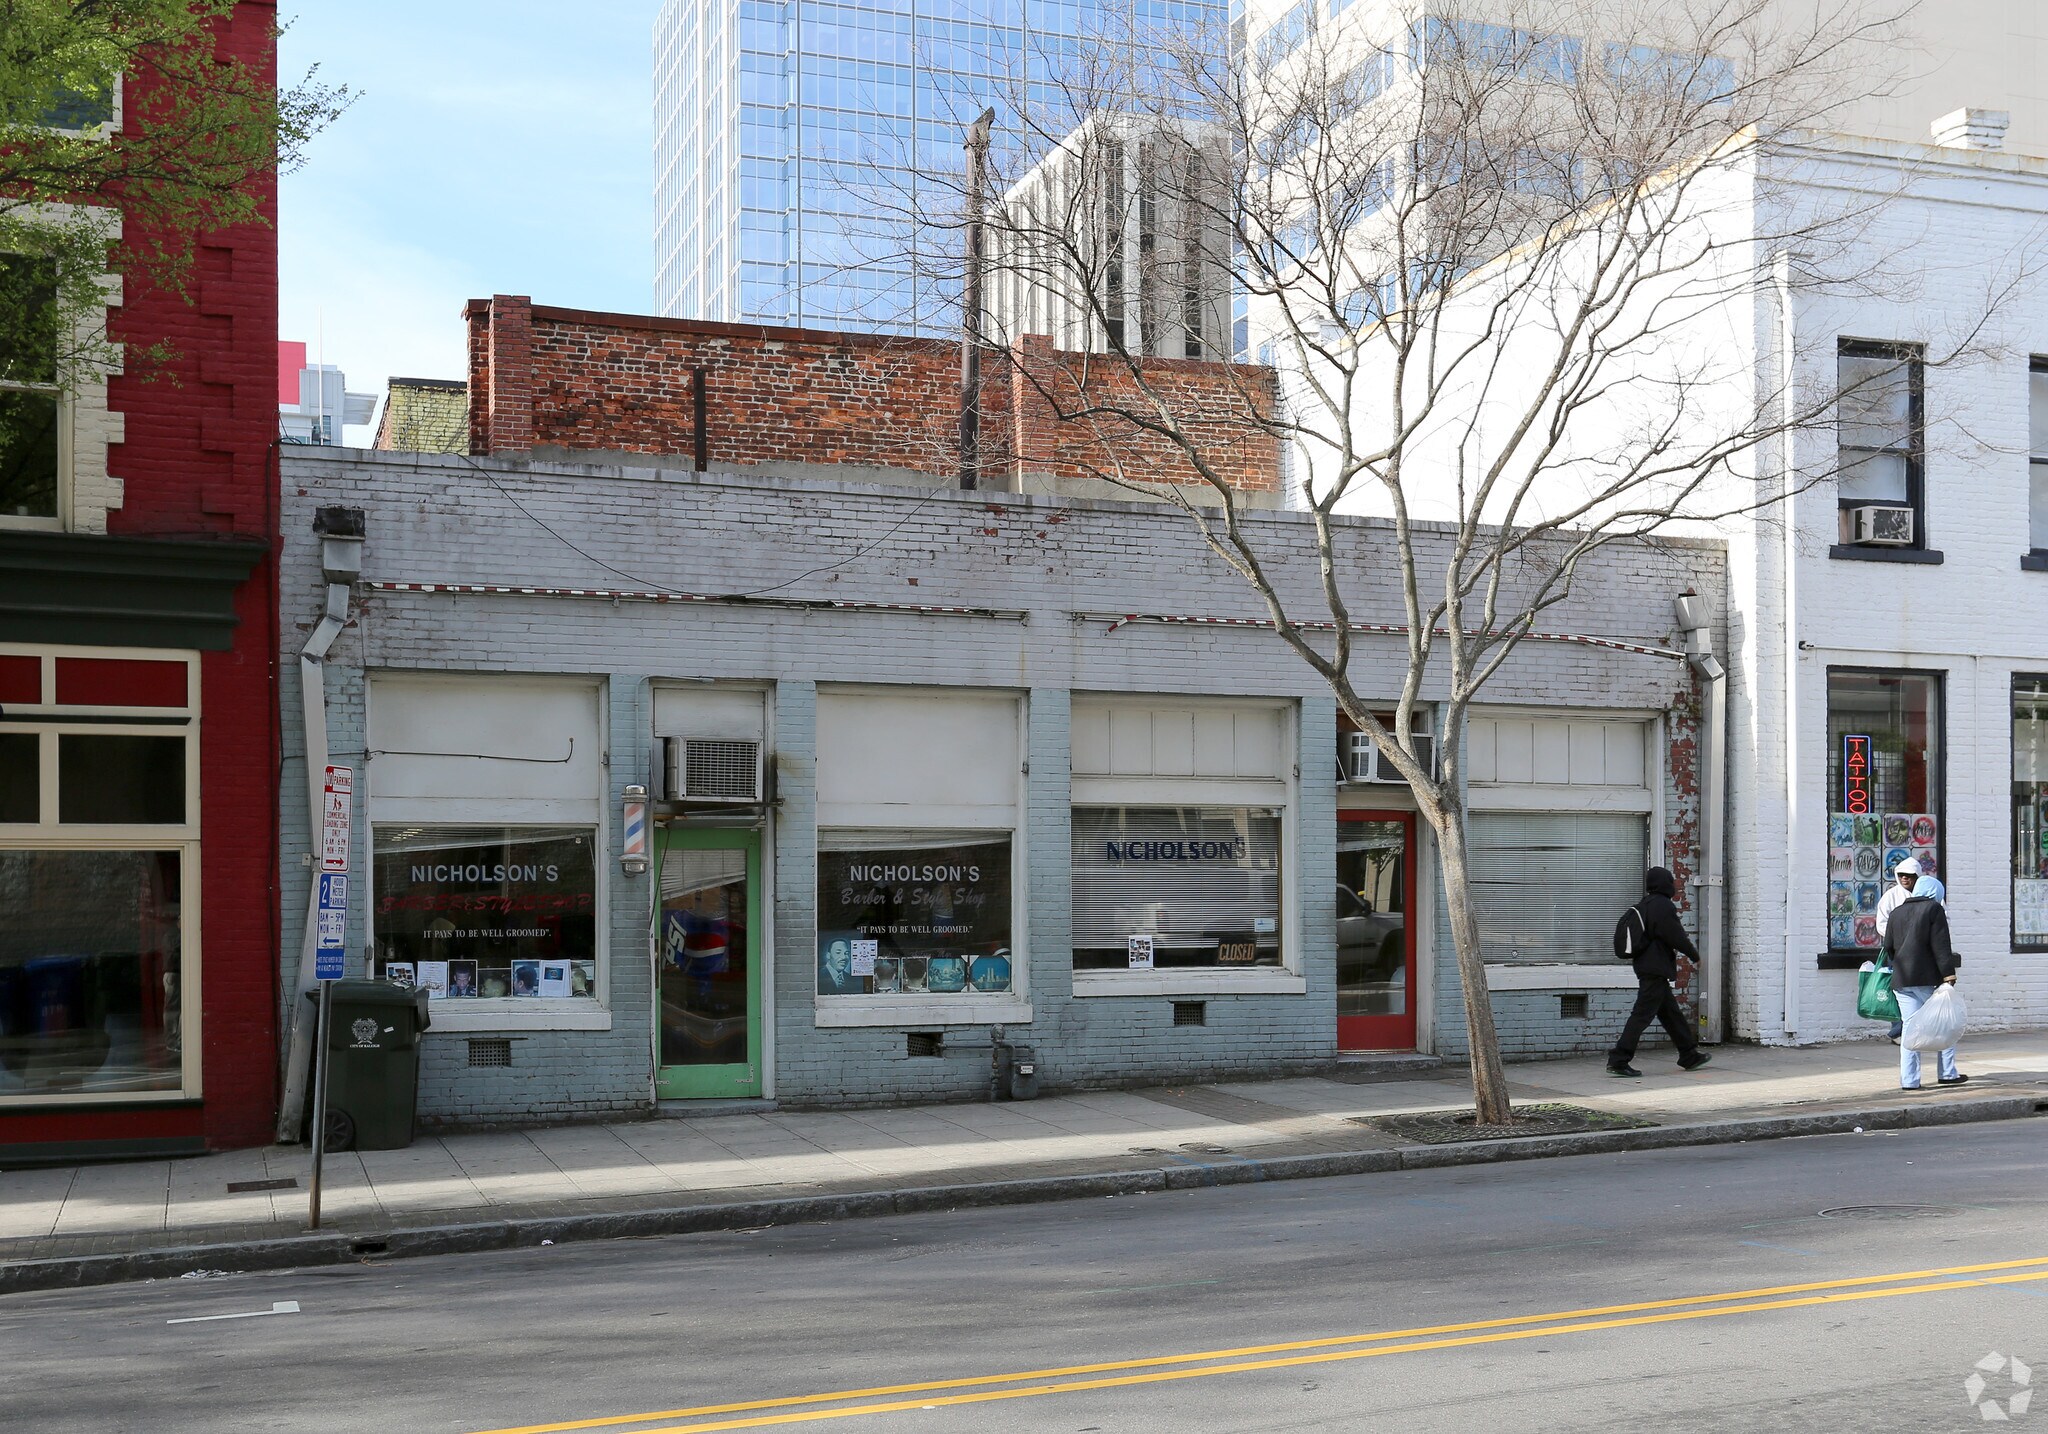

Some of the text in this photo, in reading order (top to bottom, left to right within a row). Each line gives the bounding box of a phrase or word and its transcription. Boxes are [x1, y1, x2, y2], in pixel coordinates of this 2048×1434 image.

[325, 772, 351, 787] NO PARKING
[1848, 739, 1867, 813] TATTOO
[326, 811, 347, 820] COMMERCIAL
[325, 819, 348, 829] LOADING ZONE
[332, 829, 341, 837] ONLY
[326, 846, 334, 854] MON
[1106, 838, 1246, 861] NICHOLSON'S
[411, 864, 559, 882] NICHOLSON'S
[850, 865, 980, 882] NICHOLSON'S
[333, 877, 344, 887] HOUR
[321, 880, 328, 904] 2
[332, 887, 344, 897] METER
[330, 897, 346, 906] PARKING
[841, 887, 886, 905] Barber
[893, 887, 903, 905] &
[953, 887, 986, 909] Shop
[320, 924, 329, 933] MON
[335, 924, 344, 933] FRI
[870, 926, 886, 934] PAYS
[888, 926, 898, 934] TO
[900, 926, 909, 934] BE
[911, 926, 931, 934] WELL
[423, 930, 431, 939] IT
[434, 930, 452, 939] PAYS
[455, 930, 466, 938] TO
[468, 930, 478, 938] BE
[481, 929, 503, 938] WELL
[1219, 943, 1255, 962] CLOSED
